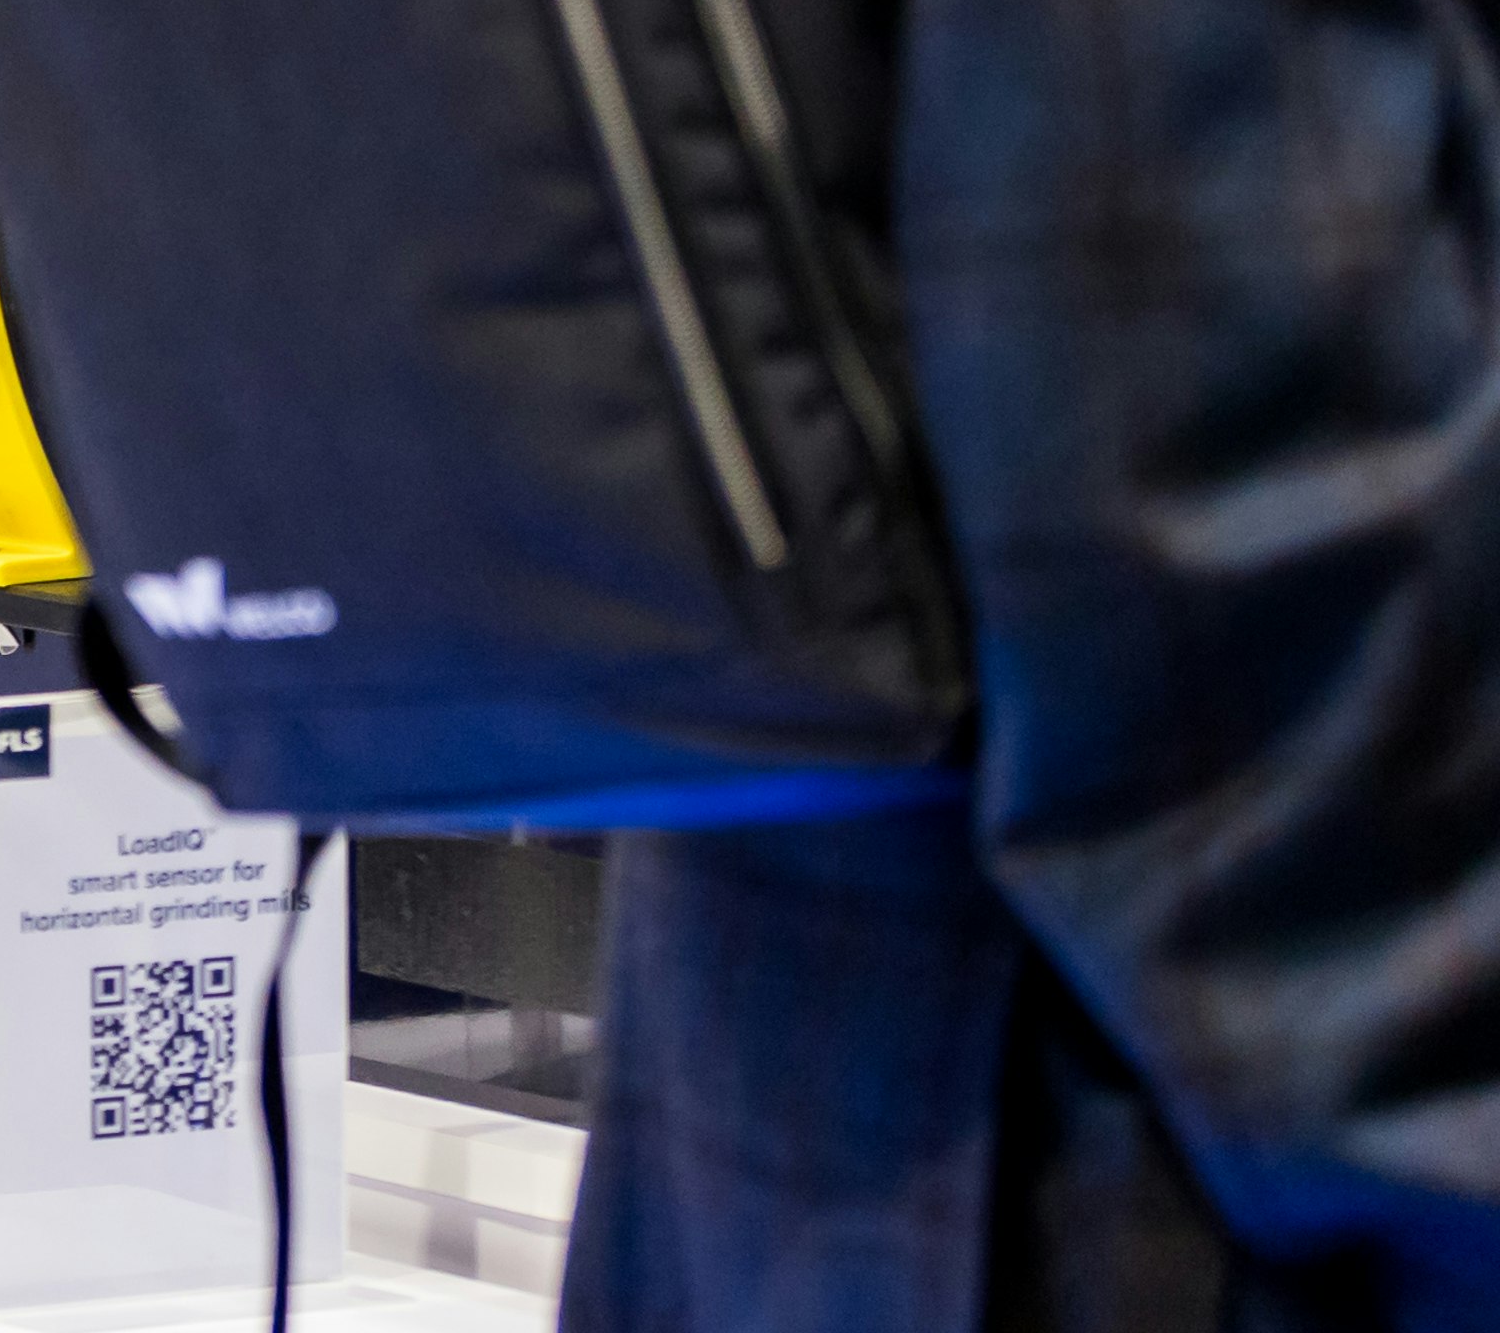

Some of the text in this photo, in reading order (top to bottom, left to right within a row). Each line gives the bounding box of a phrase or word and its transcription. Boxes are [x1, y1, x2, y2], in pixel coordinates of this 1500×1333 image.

[68, 859, 266, 895] smart sensor for
[20, 902, 143, 933] horizontal
[149, 897, 250, 928] grinding
